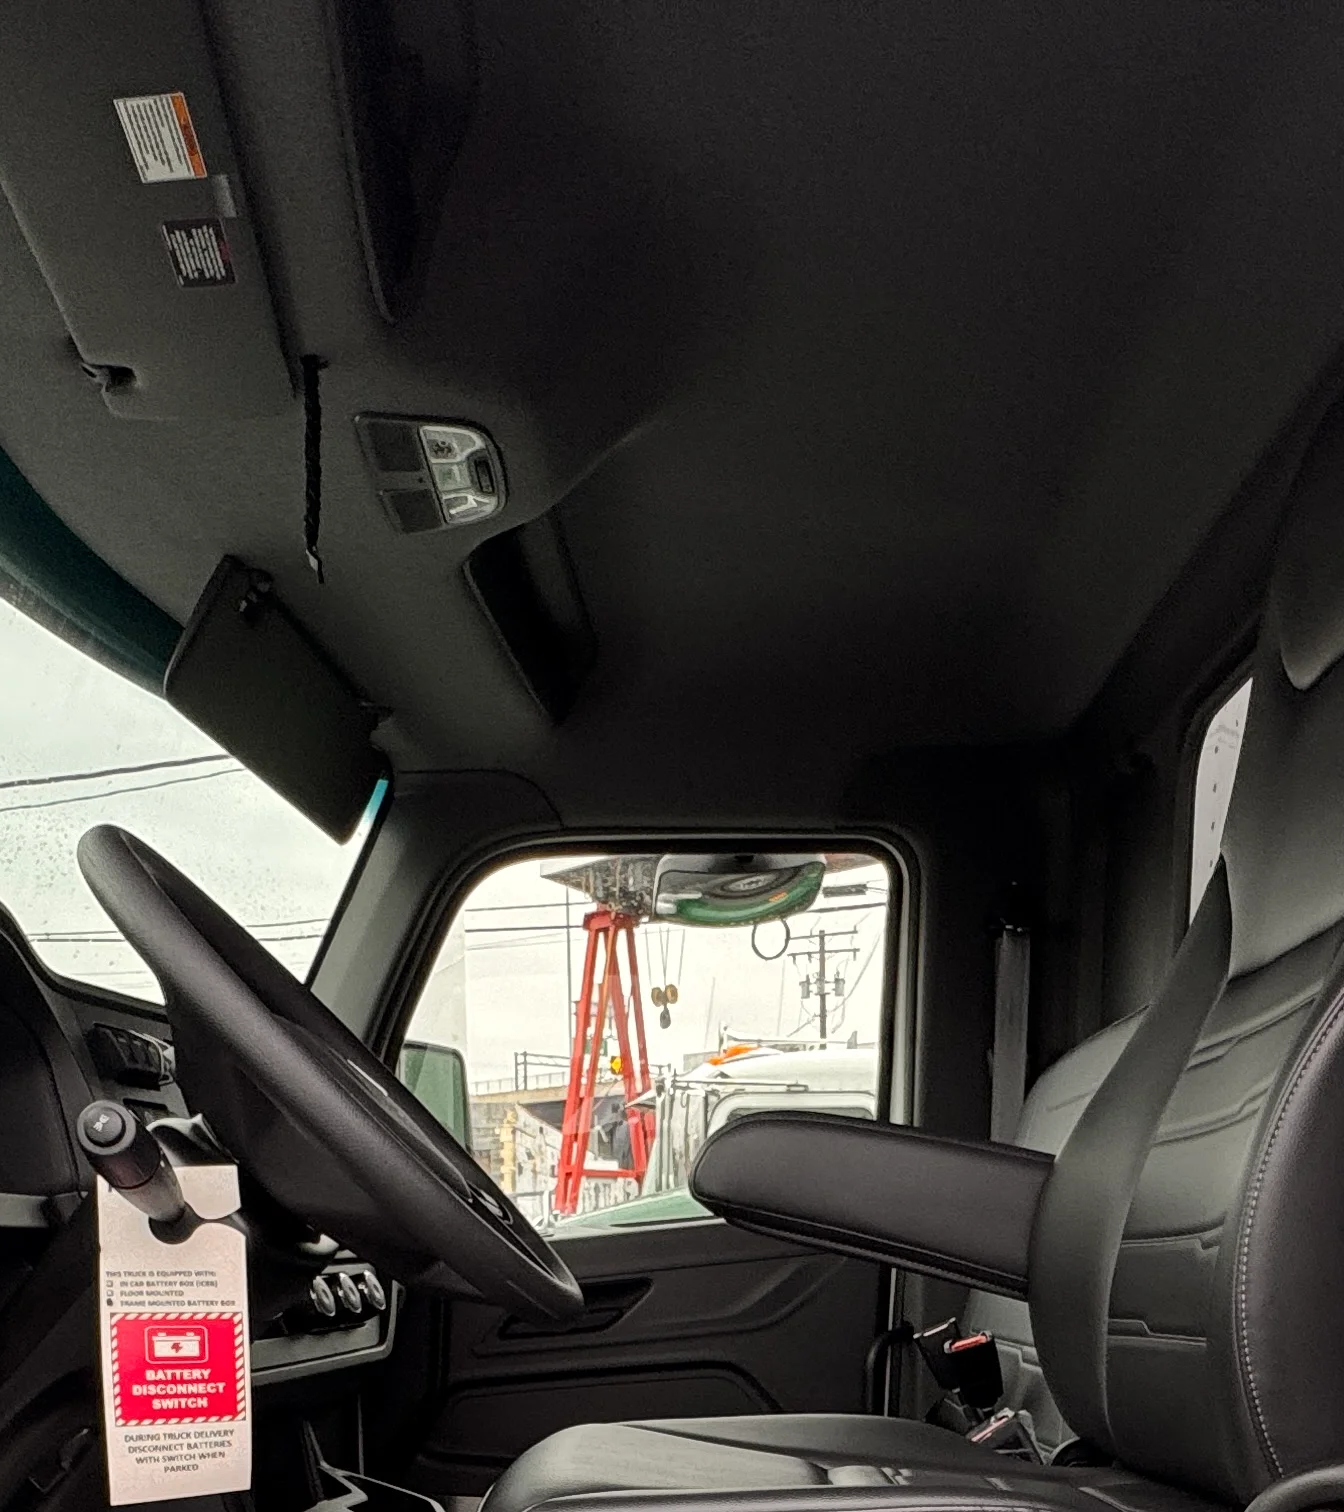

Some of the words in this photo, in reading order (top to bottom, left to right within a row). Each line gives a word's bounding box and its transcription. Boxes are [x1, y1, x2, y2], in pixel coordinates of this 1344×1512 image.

[145, 1368, 211, 1381] BATTERY
[132, 1382, 226, 1396] DISCONNECT
[152, 1397, 208, 1410] SWITCH
[124, 1433, 161, 1443] DURING
[163, 1431, 192, 1441] TRUCK
[194, 1429, 235, 1440] DELIVERY
[128, 1443, 184, 1454] DISCONNECT
[186, 1440, 232, 1451] BATTERIES
[135, 1455, 160, 1465] WITH
[162, 1453, 196, 1463] SWITCH
[198, 1451, 226, 1460] WHEN
[164, 1463, 199, 1473] PARKED
